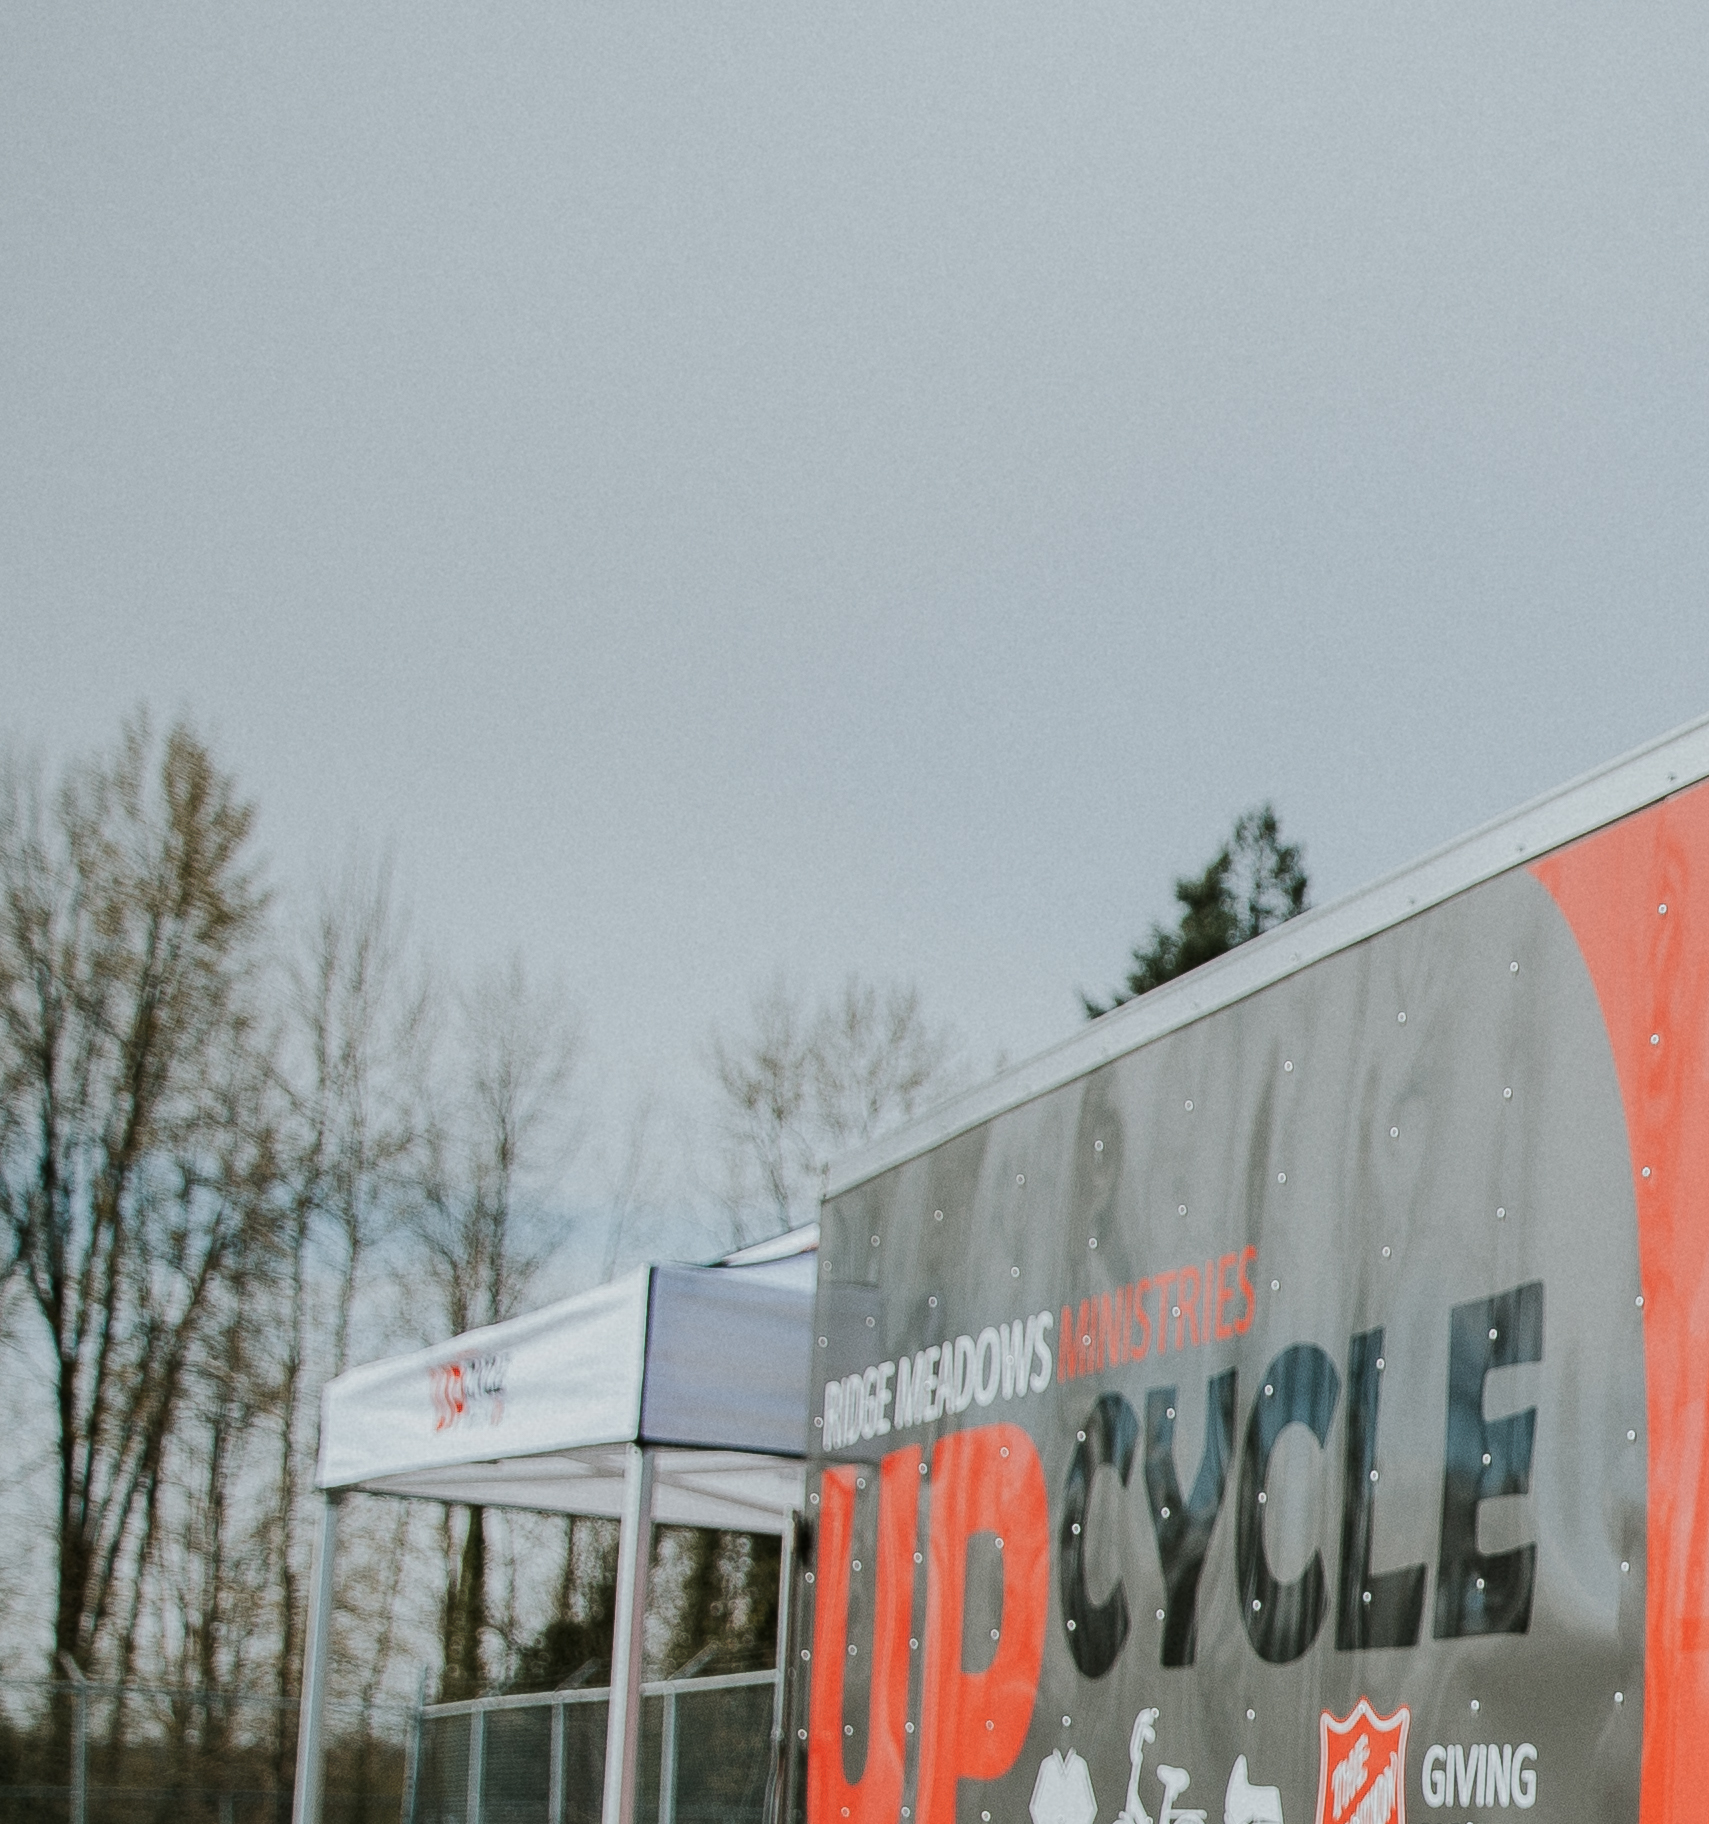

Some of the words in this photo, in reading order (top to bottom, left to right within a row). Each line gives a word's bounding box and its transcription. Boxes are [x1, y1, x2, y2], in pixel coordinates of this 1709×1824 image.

[822, 1360, 896, 1451] RIDGE
[894, 1310, 1054, 1430] MEADOWS
[1057, 1244, 1258, 1384] MINISTRIES
[1421, 1742, 1538, 1809] GIVING
